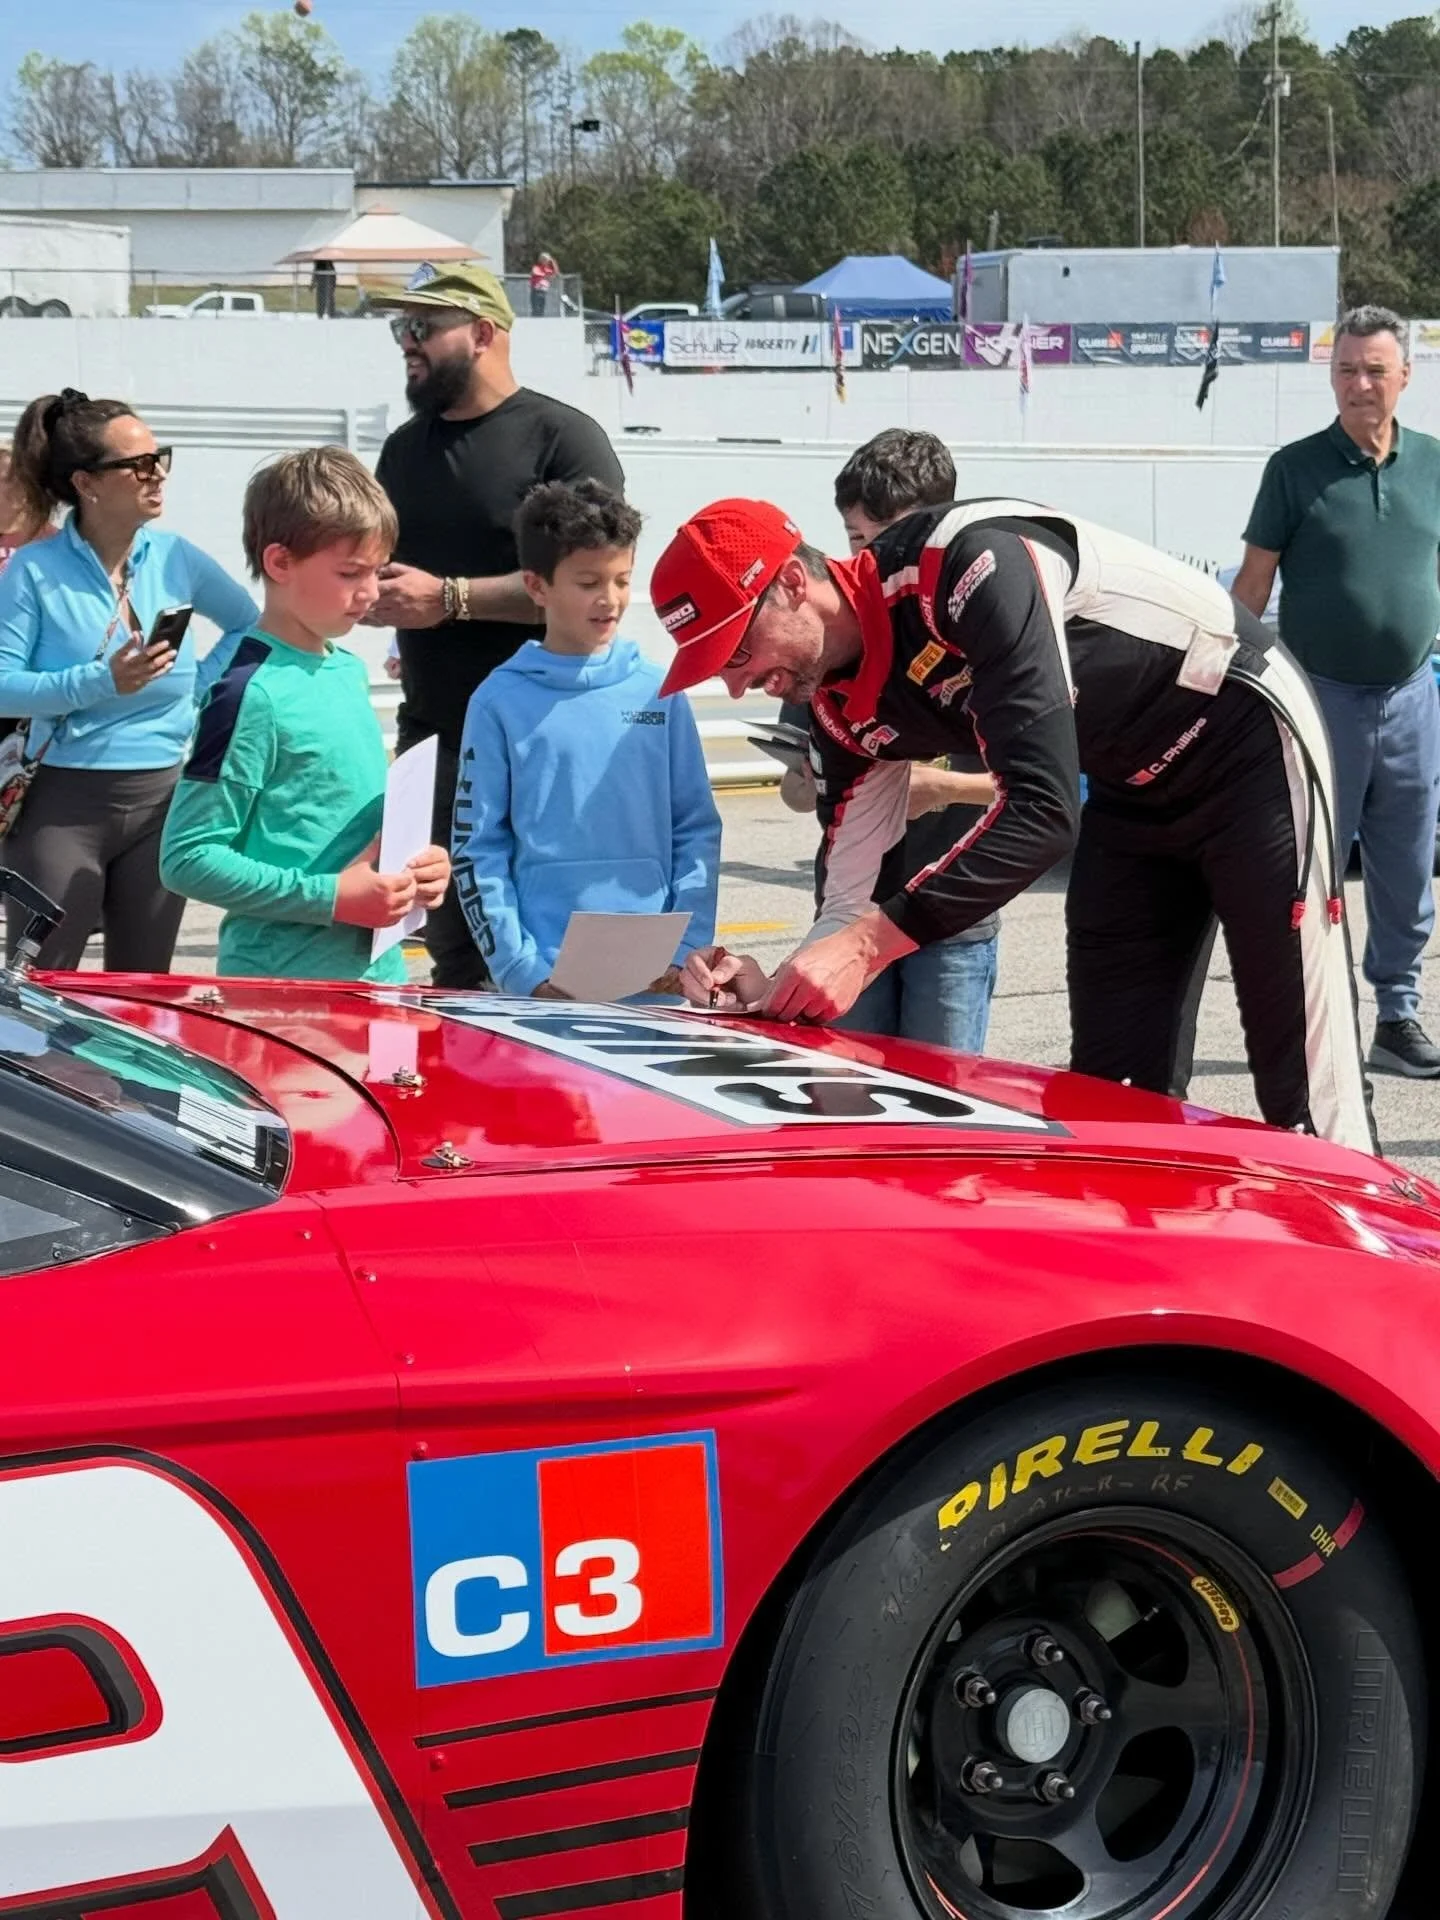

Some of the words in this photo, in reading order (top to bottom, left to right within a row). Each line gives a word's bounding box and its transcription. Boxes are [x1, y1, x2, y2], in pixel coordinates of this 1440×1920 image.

[744, 338, 798, 350] HAGERTY
[863, 331, 961, 356] NEXGEN
[955, 556, 993, 598] SCCA
[965, 562, 996, 600] RACING
[1149, 763, 1168, 774] C.
[1162, 717, 1207, 762] Phillips
[937, 1419, 1265, 1552] PIRELLI
[1309, 1523, 1337, 1558] DHA
[424, 1538, 643, 1657] C3
[1196, 1581, 1234, 1626] Bassett
